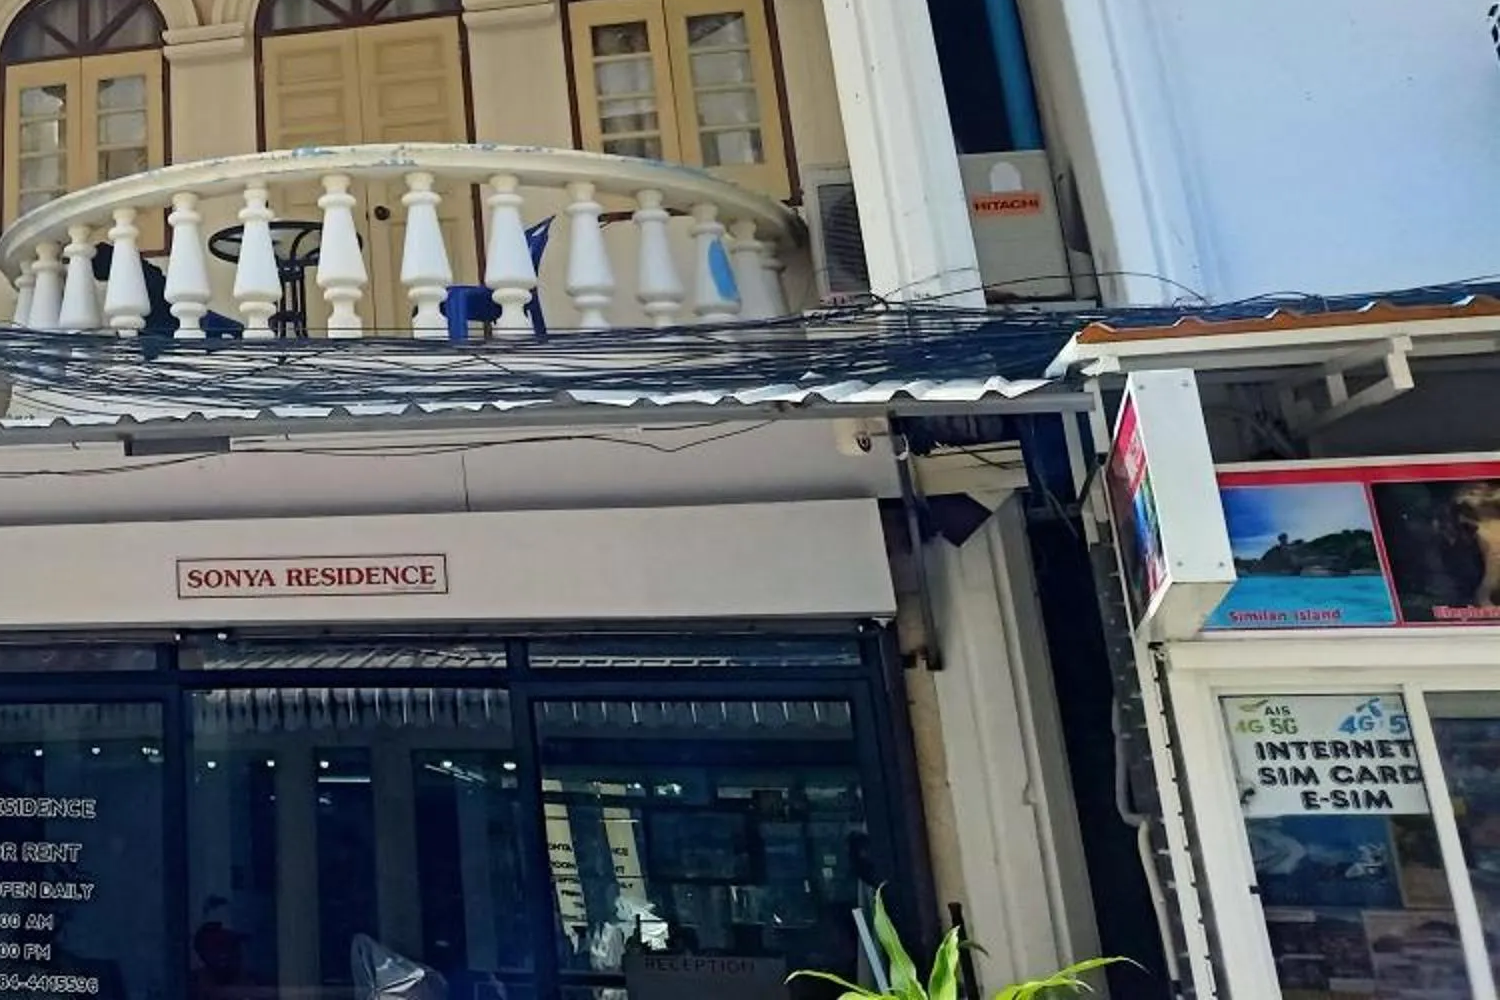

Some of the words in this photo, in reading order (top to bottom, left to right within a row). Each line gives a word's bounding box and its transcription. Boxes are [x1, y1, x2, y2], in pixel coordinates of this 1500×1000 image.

[974, 199, 1039, 211] HITACHI
[187, 568, 277, 588] SONYA
[285, 565, 437, 587] RESIDENCE
[1264, 706, 1291, 716] AIS
[1235, 719, 1263, 733] 4G
[1269, 718, 1298, 734] 5G
[1338, 715, 1376, 734] 4G
[1255, 739, 1414, 760] INTERNET
[1258, 766, 1320, 786] SIM
[1329, 765, 1422, 785] CARD
[1301, 789, 1393, 809] E-SIM
[21, 843, 82, 862] RENT
[38, 882, 95, 900] DAILY
[25, 914, 54, 931] AM
[24, 943, 51, 961] PM
[646, 957, 755, 974] RECEPTION
